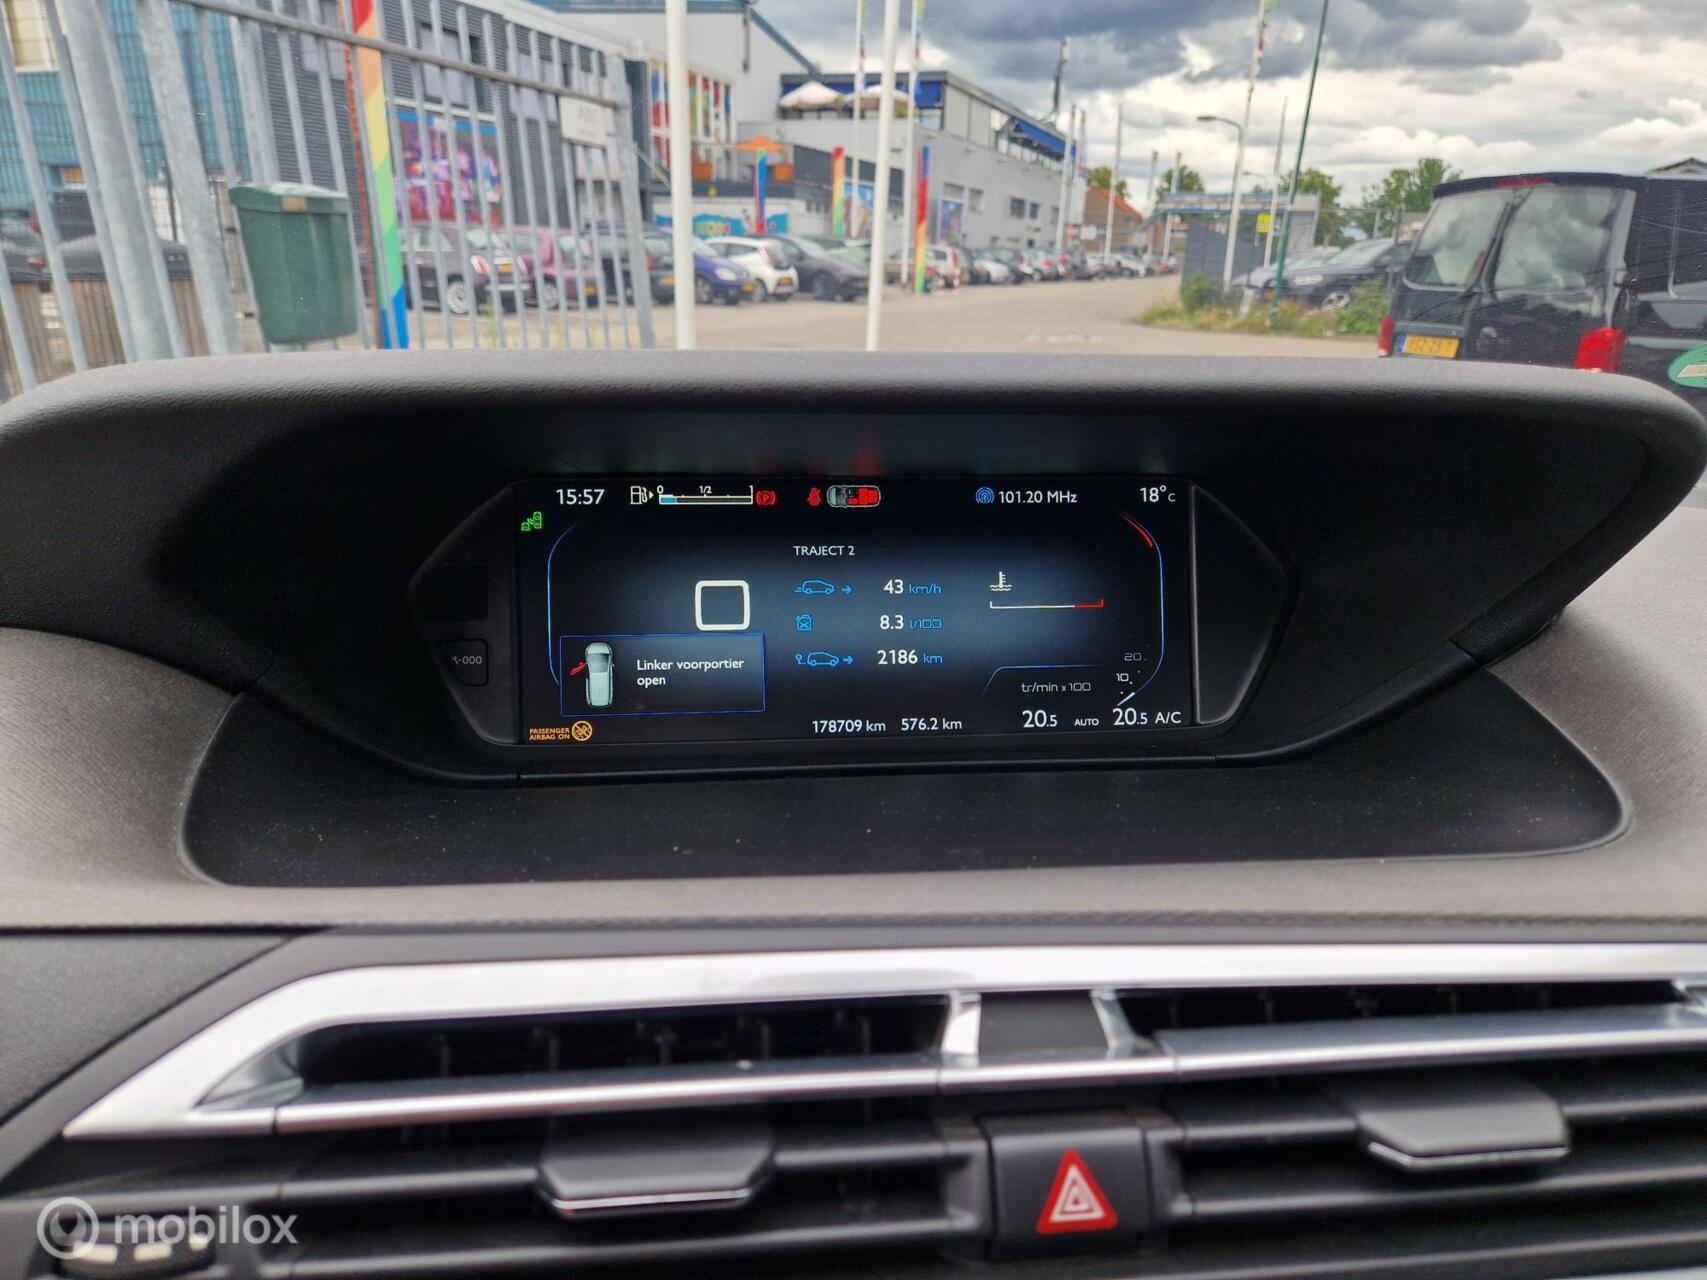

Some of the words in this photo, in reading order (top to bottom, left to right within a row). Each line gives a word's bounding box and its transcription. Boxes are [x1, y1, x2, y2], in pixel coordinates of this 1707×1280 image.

[556, 488, 605, 505] 15:57
[699, 485, 713, 494] 1/2
[998, 490, 1043, 504] 101.20
[1047, 490, 1078, 503] MHz
[793, 545, 845, 557] TRAJECT
[847, 545, 855, 556] 2
[883, 578, 904, 595] 43
[908, 583, 942, 596] km/h
[879, 614, 904, 630] 8.3
[877, 649, 918, 665] 2186
[923, 653, 943, 665] km
[1123, 652, 1142, 662] 20
[636, 658, 673, 671] Linker
[676, 657, 745, 674] voorportier
[636, 676, 666, 689] open
[1115, 672, 1130, 682] 10
[1020, 681, 1059, 693] tr/min
[1022, 709, 1058, 728] 20.5
[1074, 718, 1100, 727] AUTO
[1112, 707, 1148, 726] 20.5
[1154, 711, 1182, 724] A/C
[529, 727, 570, 735] PASSENGER
[812, 719, 863, 734] 178709
[865, 719, 886, 733] km
[901, 717, 939, 732] 576.2
[942, 717, 963, 731] km
[528, 733, 556, 741] AIRBAG
